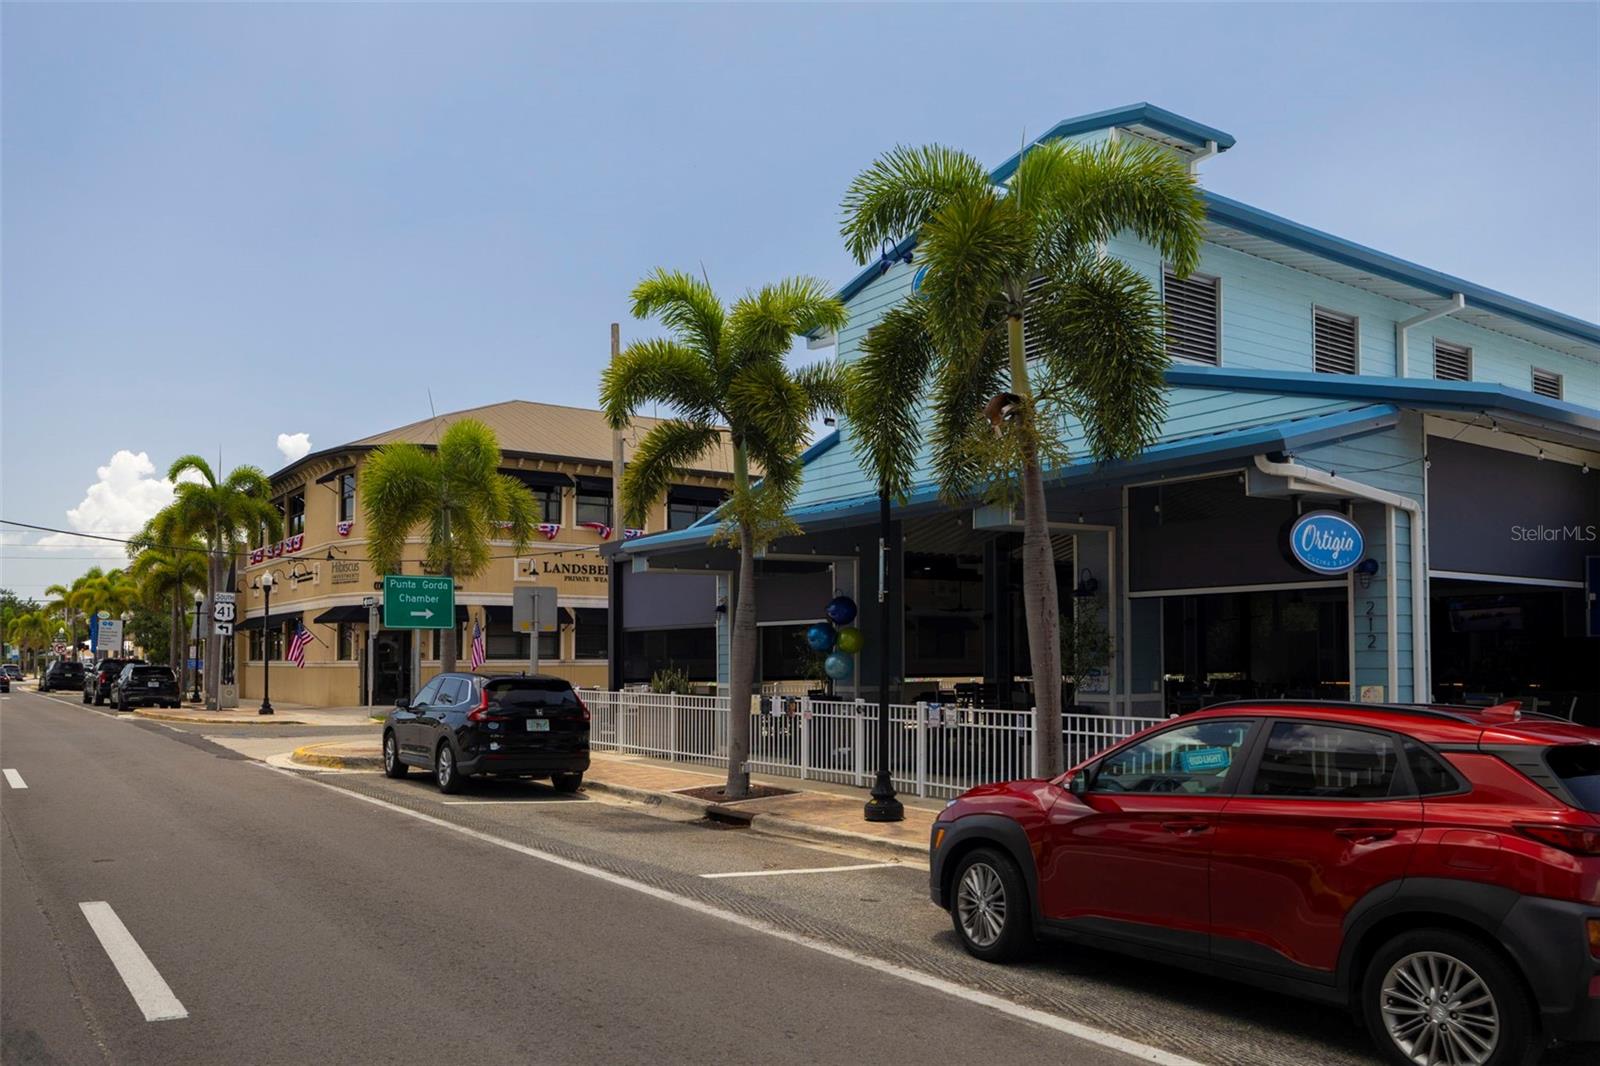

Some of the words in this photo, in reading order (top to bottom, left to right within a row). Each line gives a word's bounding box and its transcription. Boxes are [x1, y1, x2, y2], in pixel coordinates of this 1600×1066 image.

[1302, 524, 1354, 560] Ortigia
[331, 561, 359, 573] Hibiscus
[389, 579, 417, 589] Punta
[421, 580, 449, 590] Gorda
[398, 593, 440, 603] Chamber
[217, 606, 231, 617] 41
[1366, 601, 1377, 649] 212
[1203, 754, 1222, 763] LIGHT
